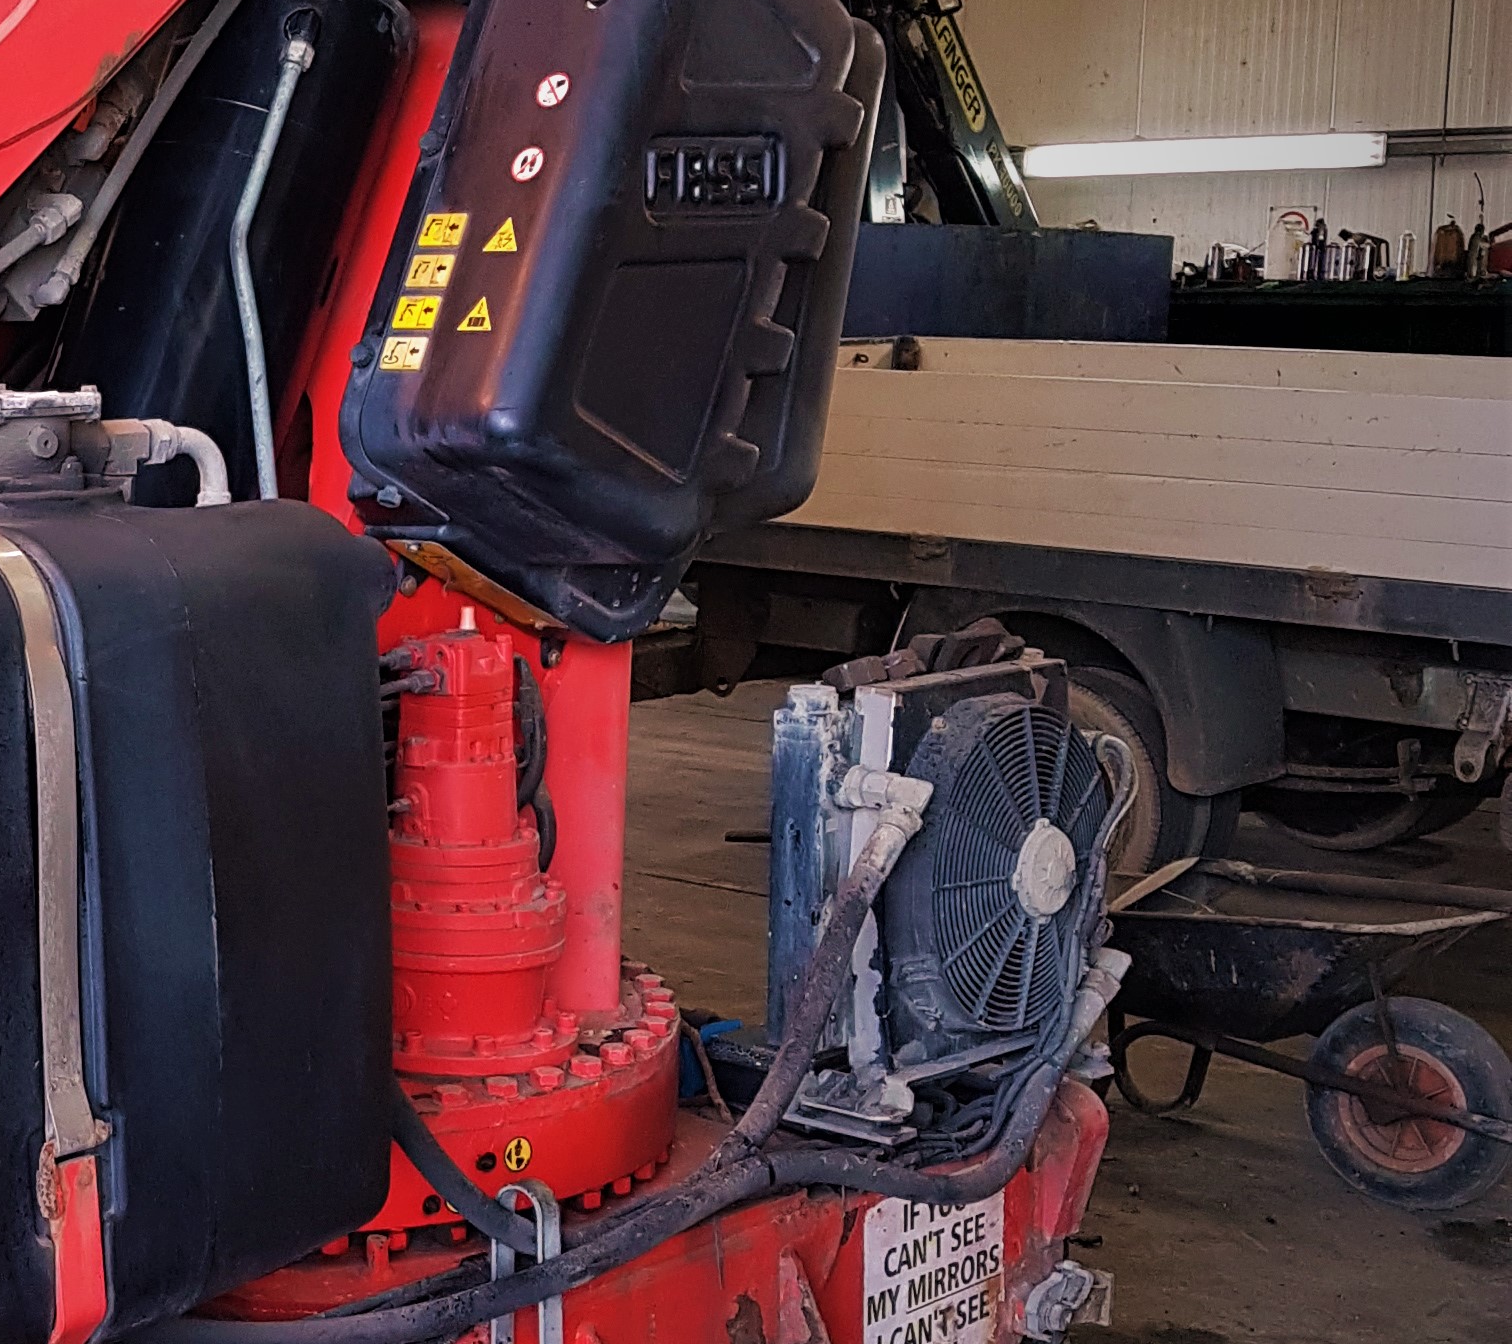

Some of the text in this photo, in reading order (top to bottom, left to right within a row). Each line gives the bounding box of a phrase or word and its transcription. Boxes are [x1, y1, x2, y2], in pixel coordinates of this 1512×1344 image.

[903, 1201, 920, 1232] IF
[884, 1212, 986, 1277] CAN'T SEE
[868, 1244, 1000, 1326] MY MIRRORS
[956, 1290, 990, 1330] SEE
